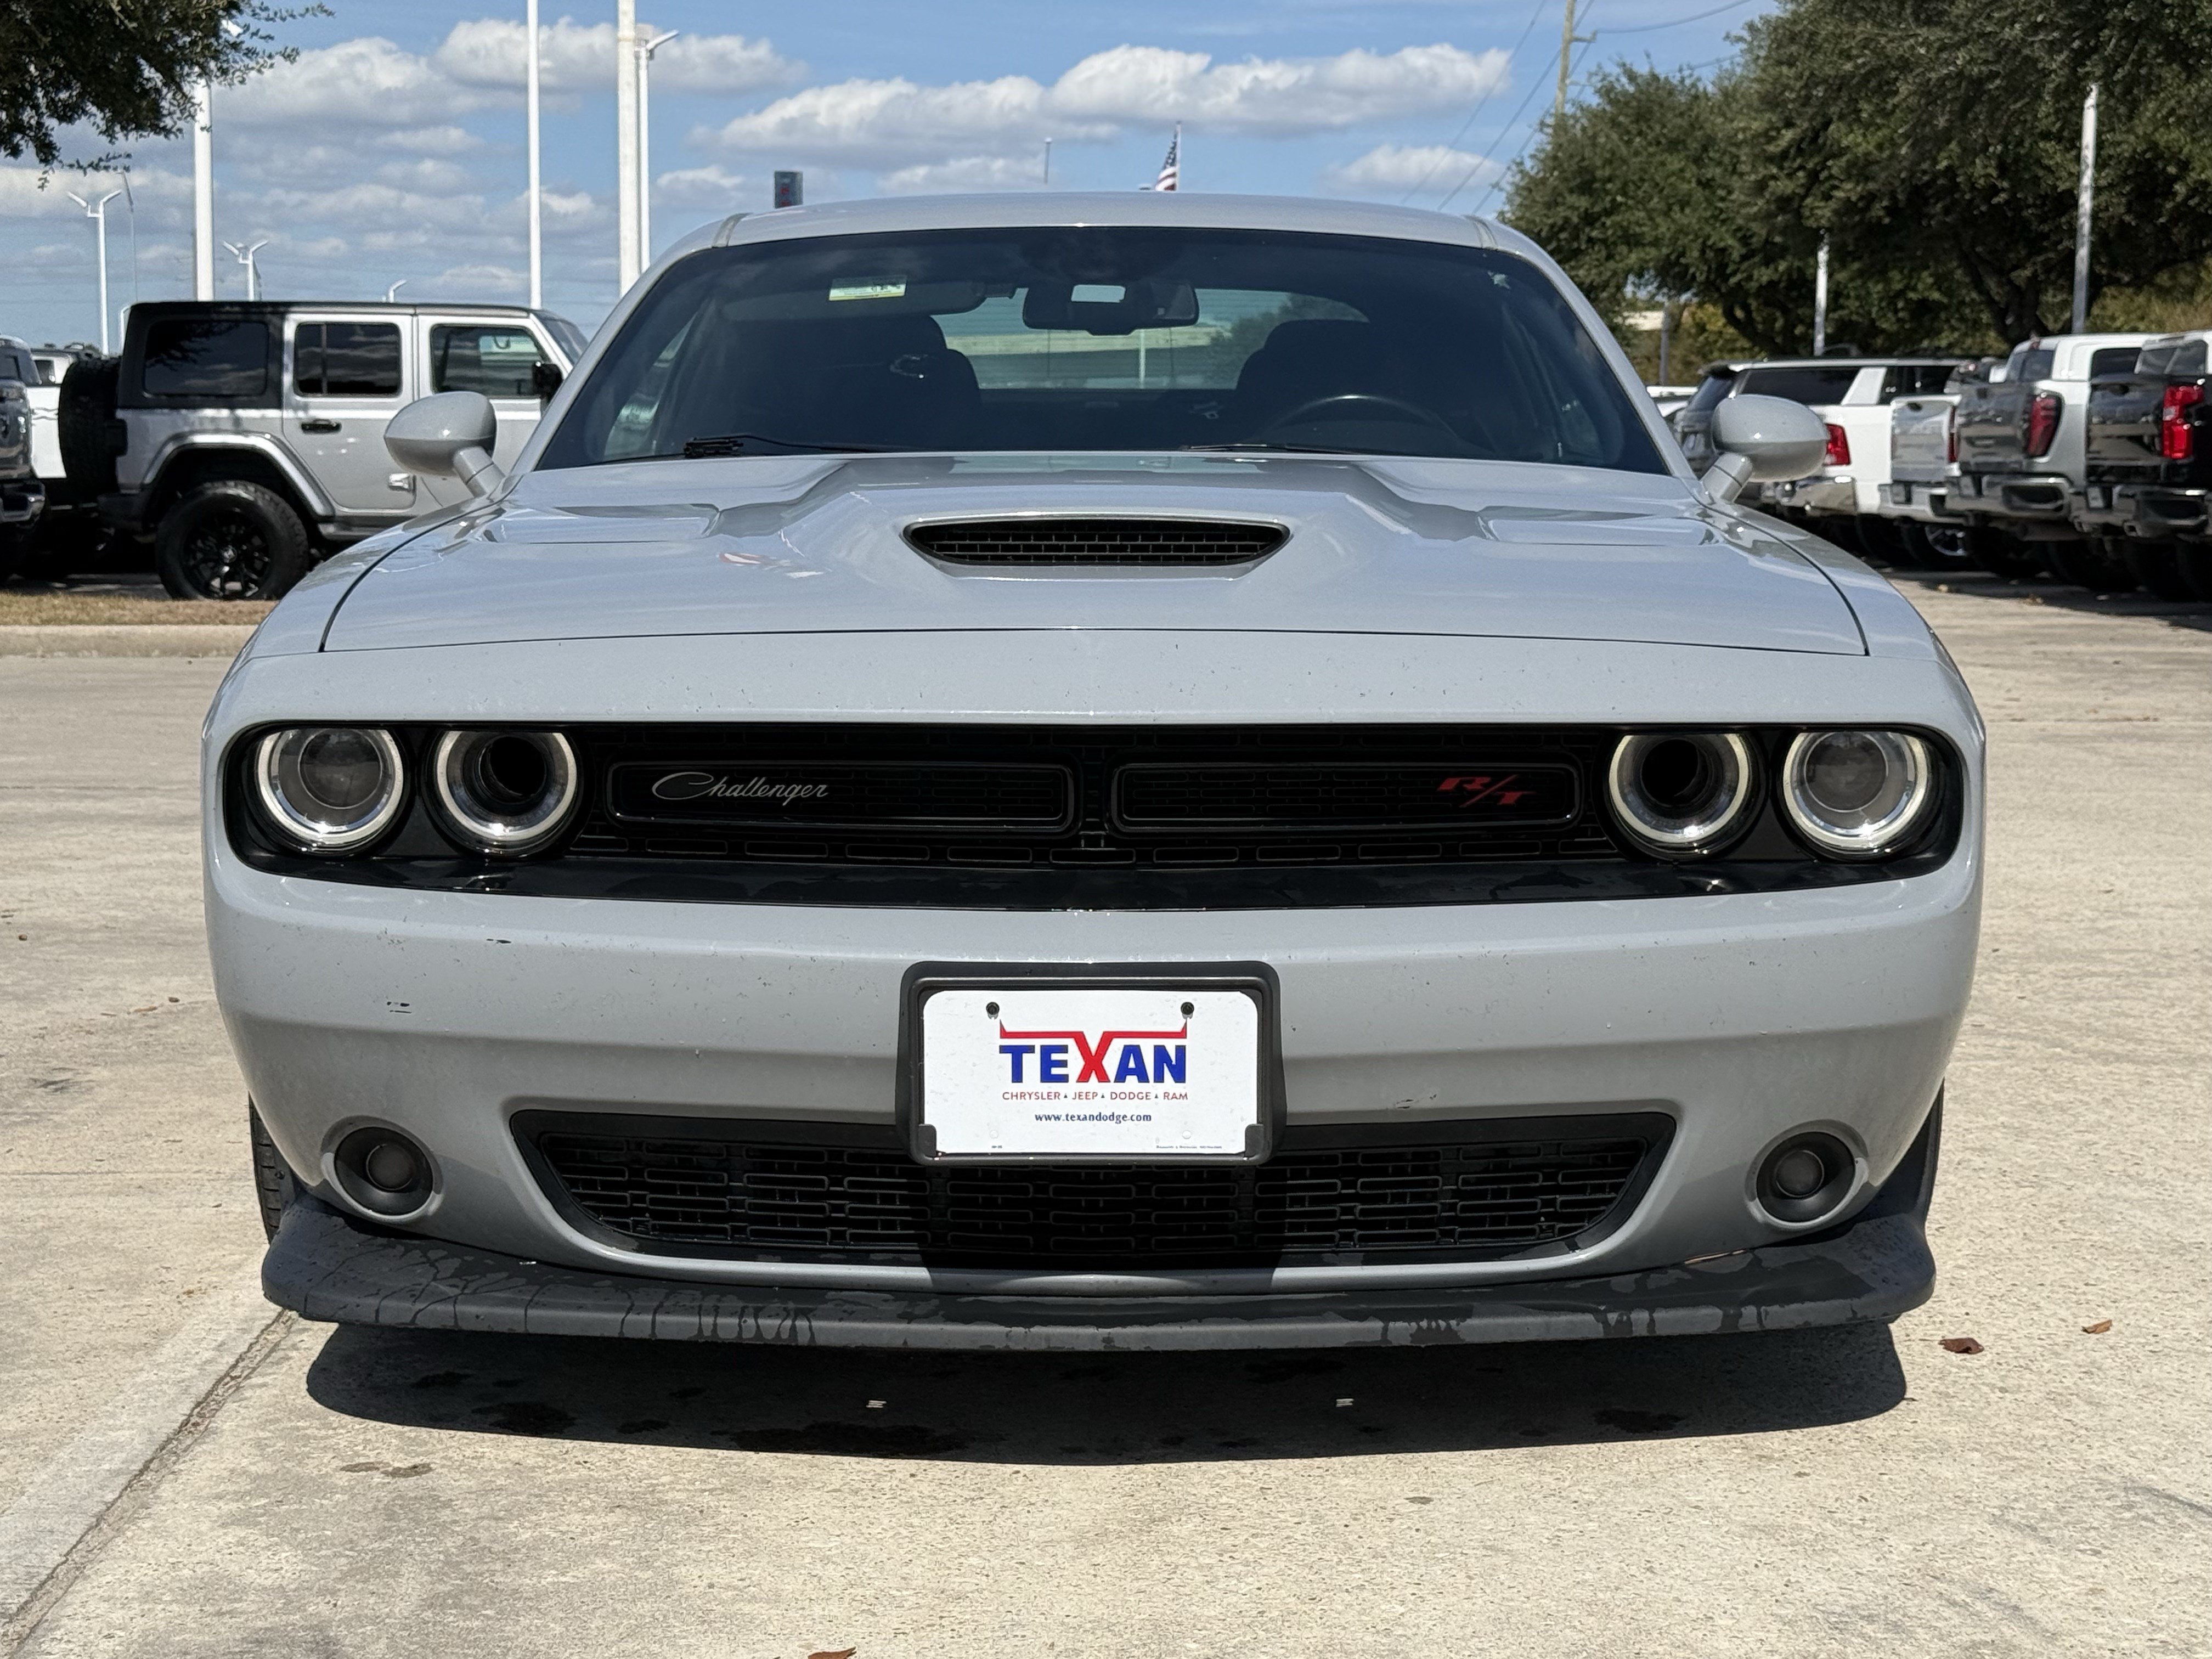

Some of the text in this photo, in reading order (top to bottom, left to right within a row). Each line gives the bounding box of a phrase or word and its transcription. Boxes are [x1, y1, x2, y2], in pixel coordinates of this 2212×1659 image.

[652, 771, 829, 806] Challenger
[1437, 774, 1536, 808] R/T
[999, 1031, 1186, 1084] TEXAN
[1002, 1092, 1188, 1101] CHRYSLER JEEP DODGE RAM
[1035, 1111, 1152, 1125] www.texandodge.com
